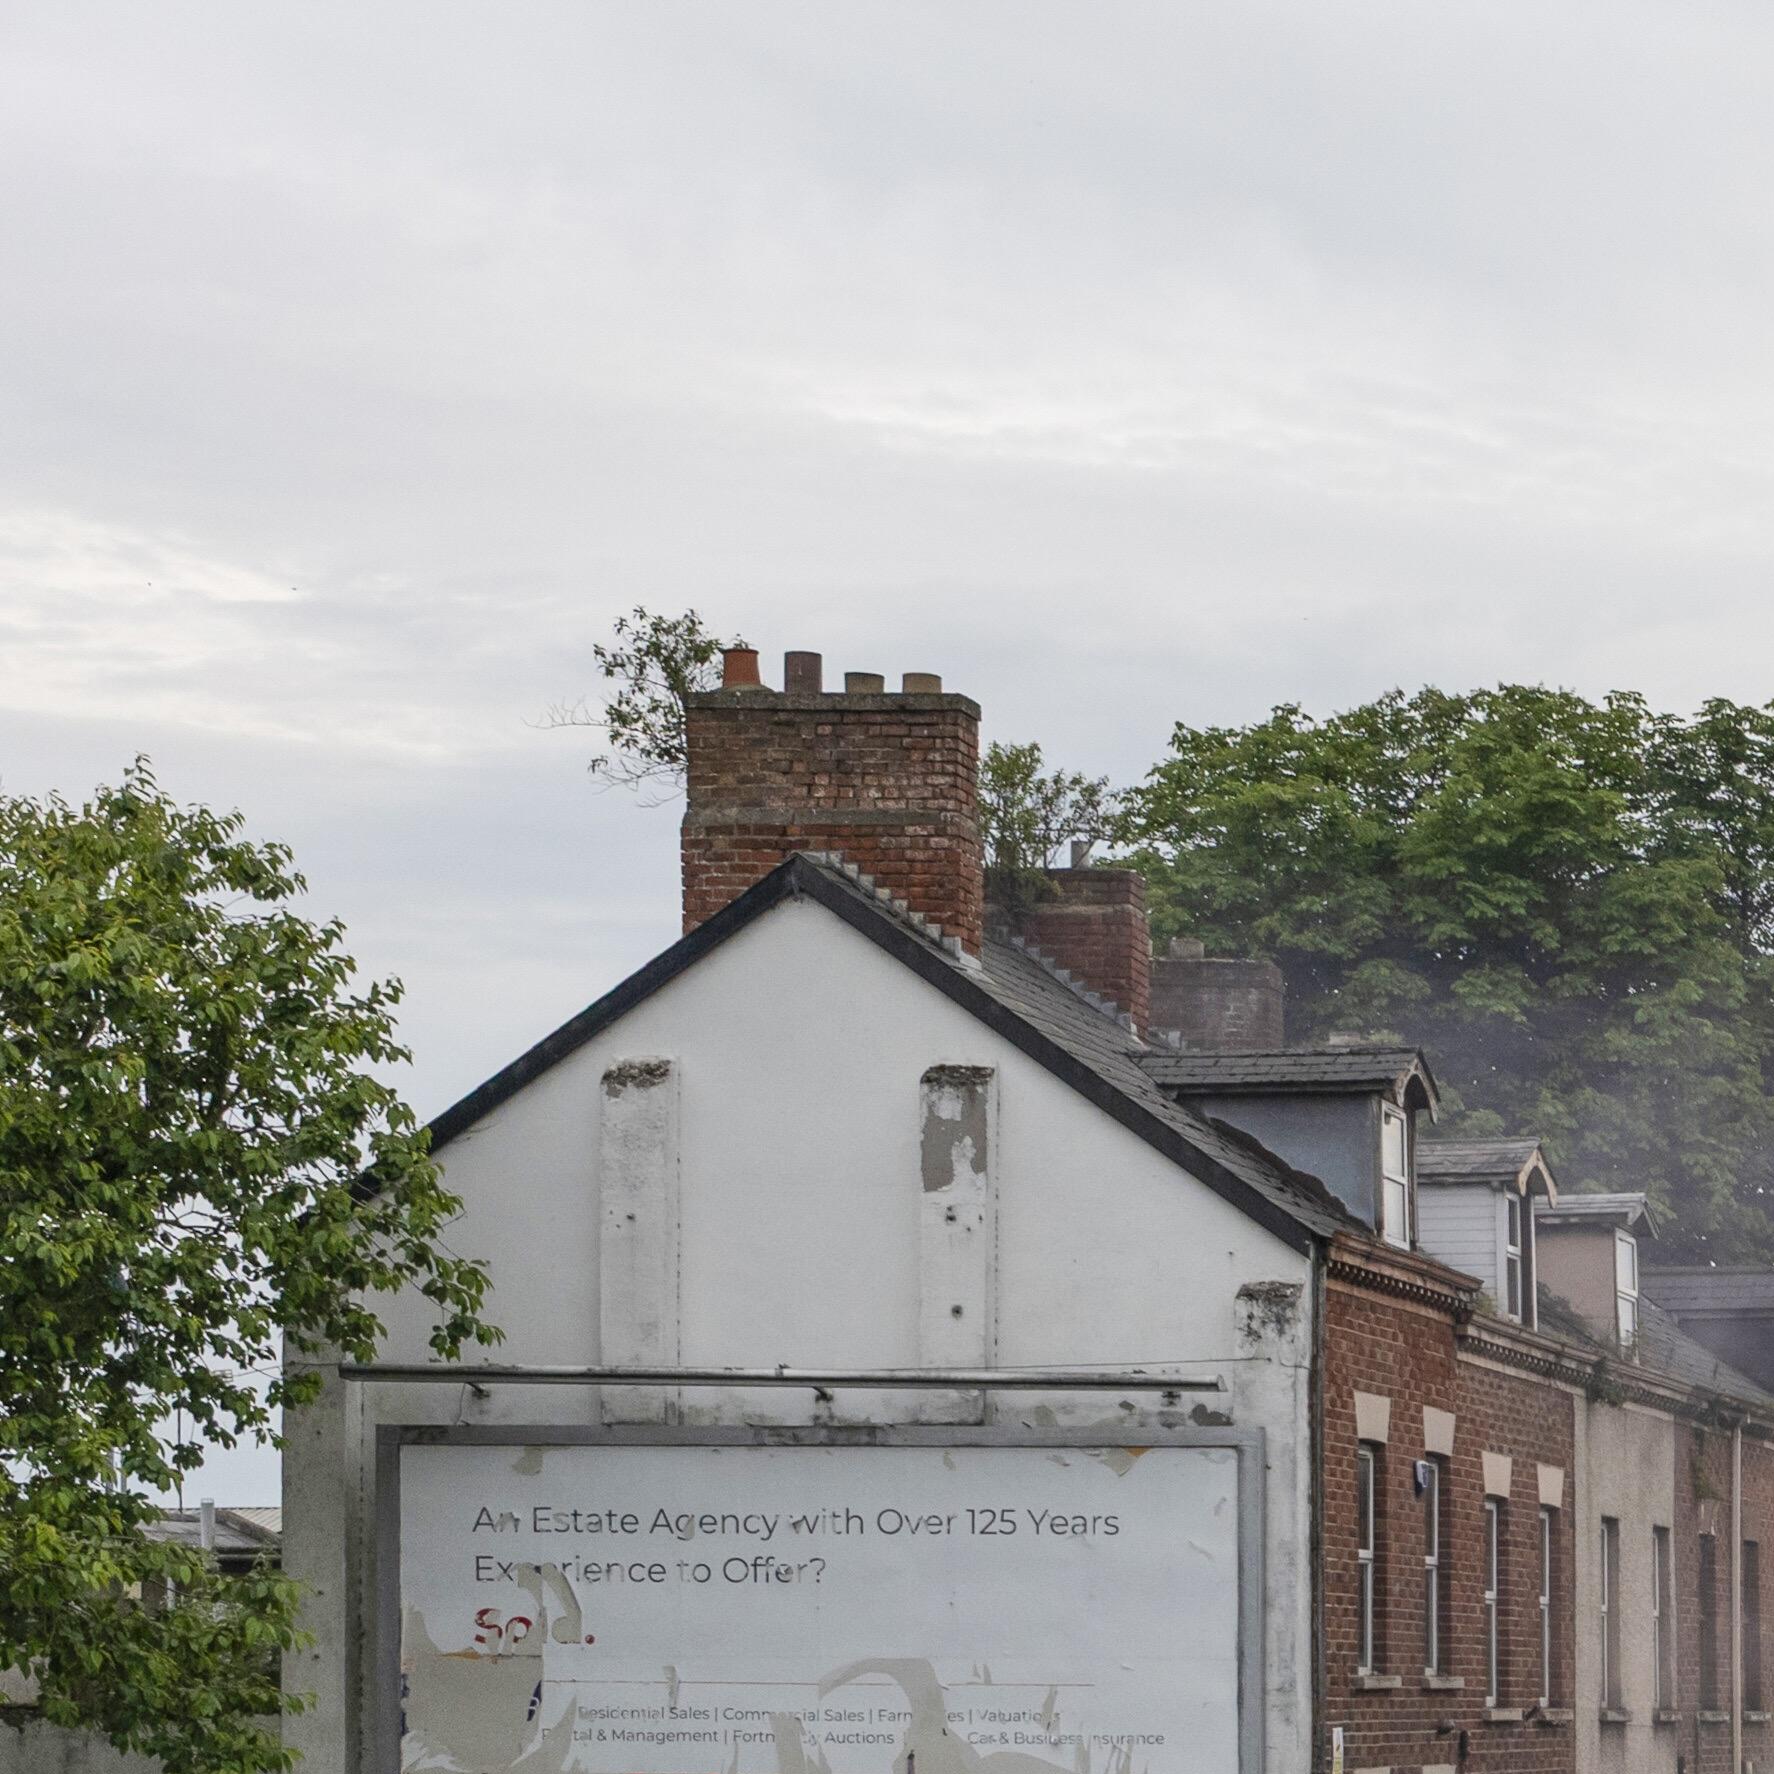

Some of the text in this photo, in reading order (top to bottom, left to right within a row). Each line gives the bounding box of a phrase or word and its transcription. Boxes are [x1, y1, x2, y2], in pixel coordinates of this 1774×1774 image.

[472, 1506, 1120, 1541] An Estate Agency with Over 125 Years
[475, 1554, 826, 1584] Exrience to Offer?
[577, 1705, 664, 1721] Residential
[669, 1705, 710, 1721] Sales
[824, 1708, 865, 1722] Sales
[596, 1728, 607, 1742] &
[612, 1728, 719, 1745] Management
[824, 1730, 895, 1745] Auctions
[998, 1731, 1010, 1746] &
